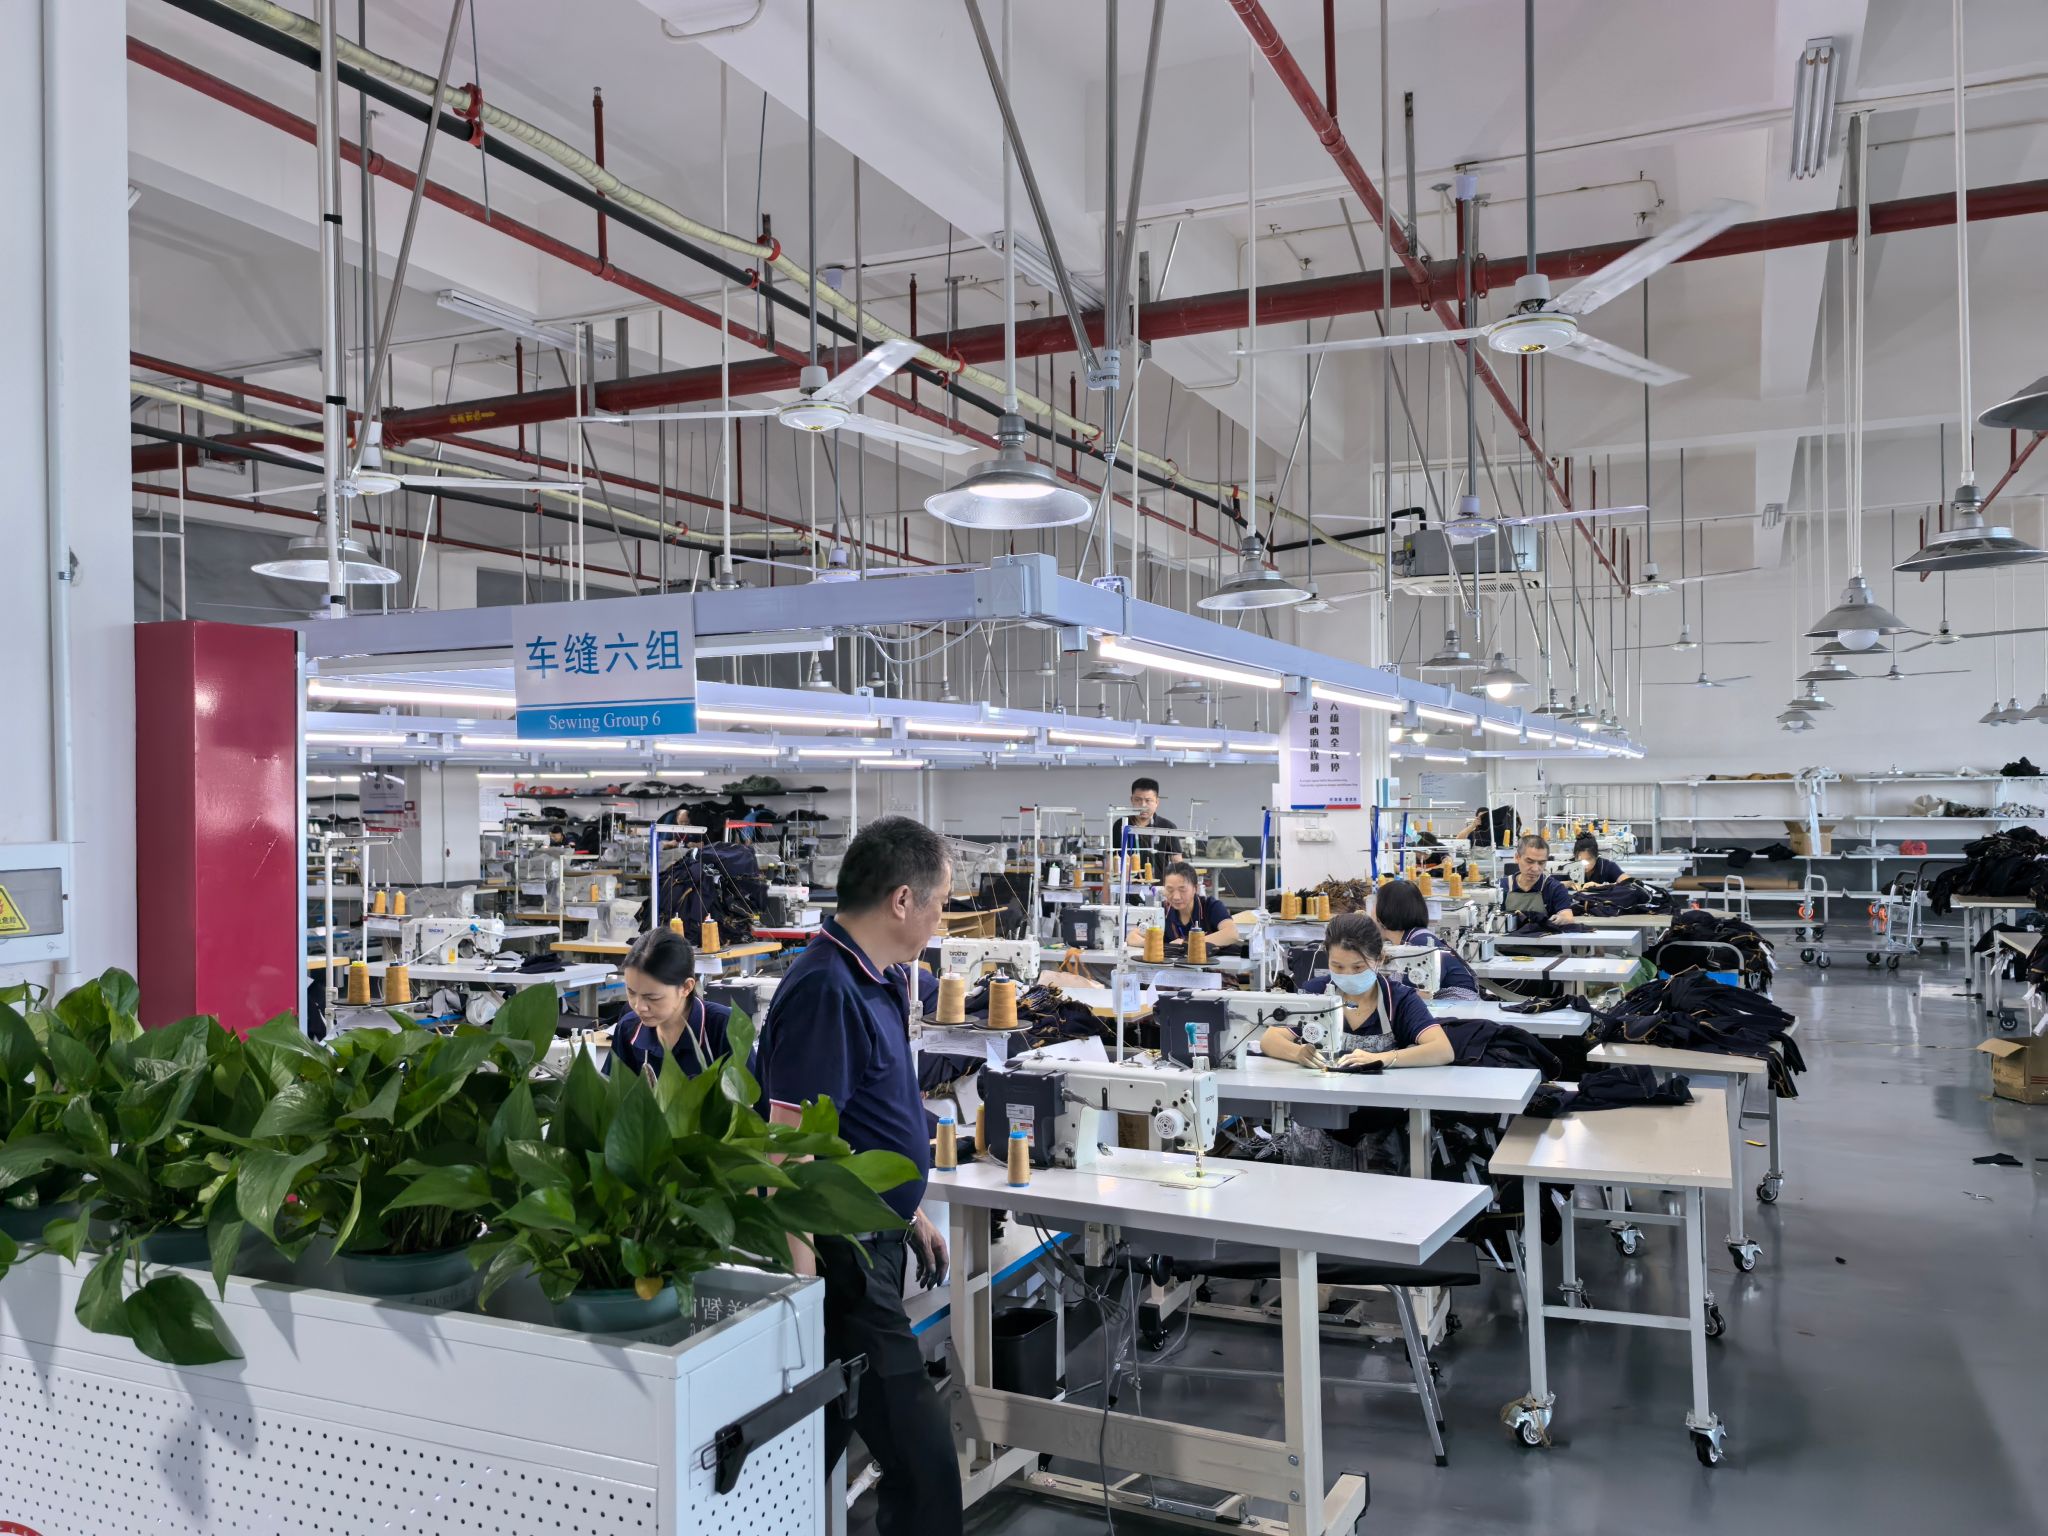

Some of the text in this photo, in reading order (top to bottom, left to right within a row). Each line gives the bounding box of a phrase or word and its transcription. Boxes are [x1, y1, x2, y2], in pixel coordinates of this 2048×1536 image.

[526, 630, 684, 679] 车缝六组
[549, 711, 661, 732] Sewing Group 6
